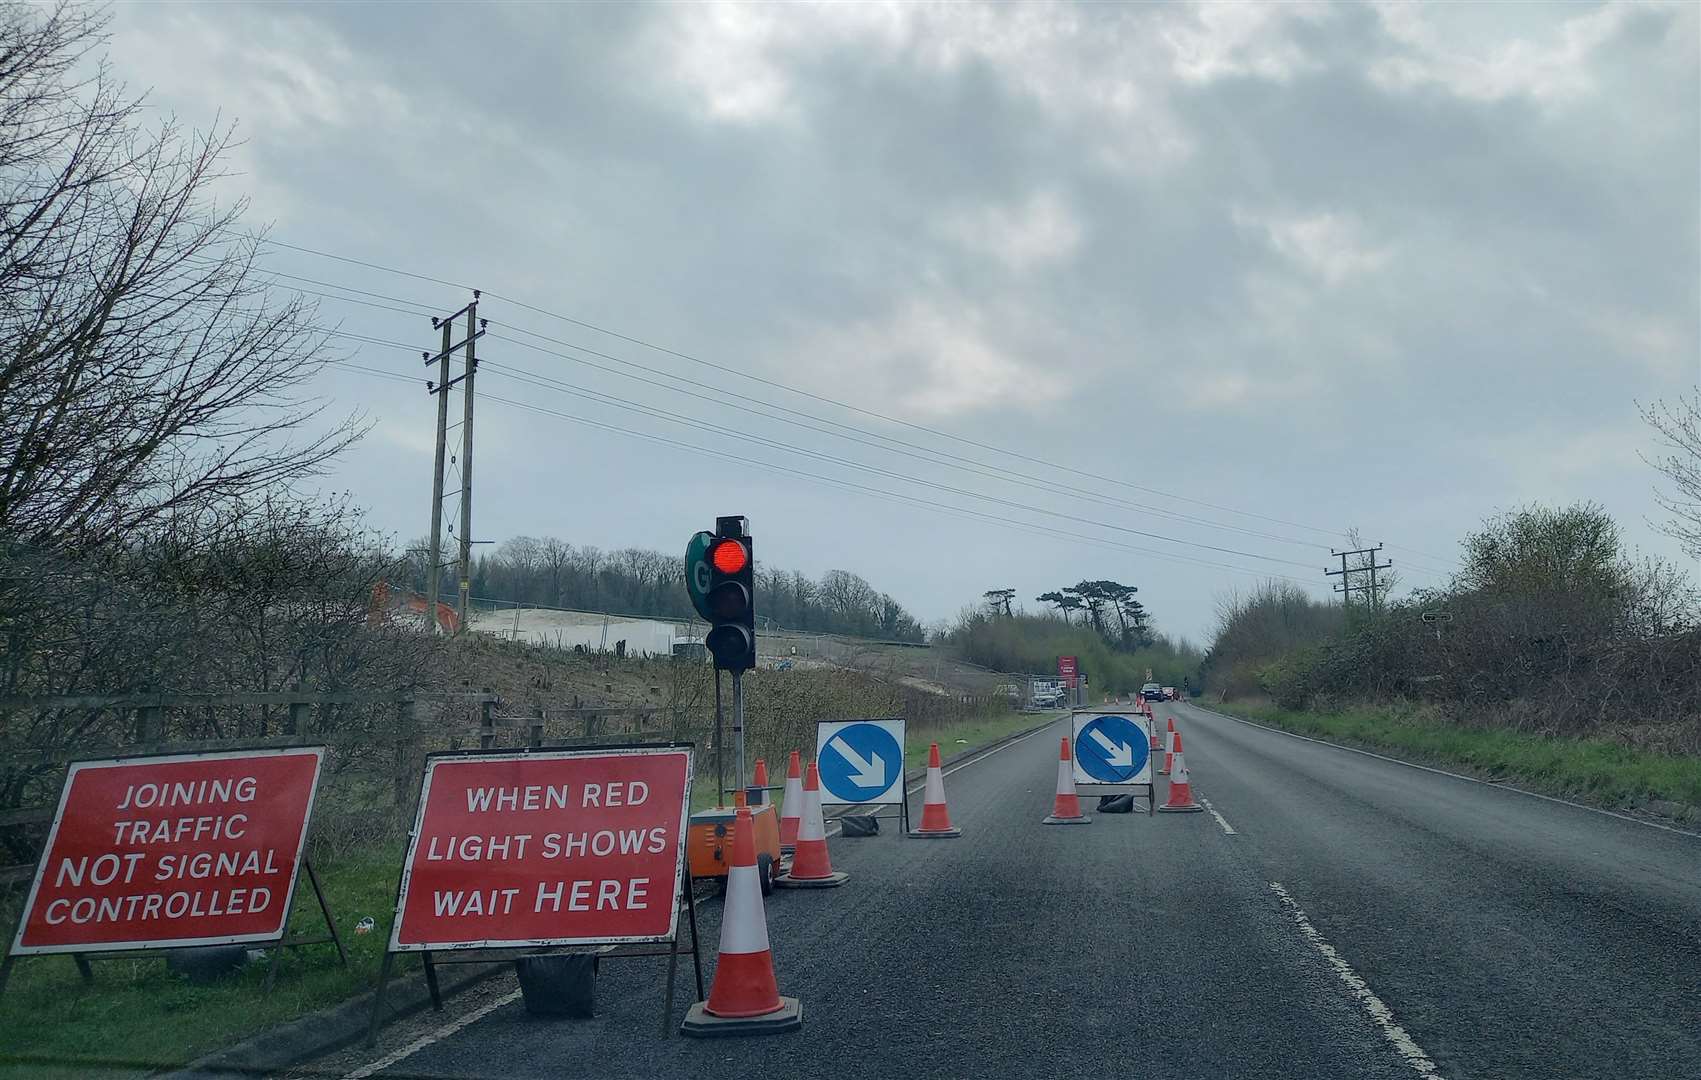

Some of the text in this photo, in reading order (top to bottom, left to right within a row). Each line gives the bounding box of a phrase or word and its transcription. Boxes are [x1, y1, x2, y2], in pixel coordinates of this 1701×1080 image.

[694, 560, 712, 594] G
[117, 777, 256, 809] JOINING
[467, 782, 648, 812] WHEN RED
[428, 828, 666, 860] LIGHT SHOWS
[56, 850, 277, 887] NOT SIGNAL
[46, 888, 270, 924] CONTROLLED
[435, 878, 649, 916] WAIT HERE
